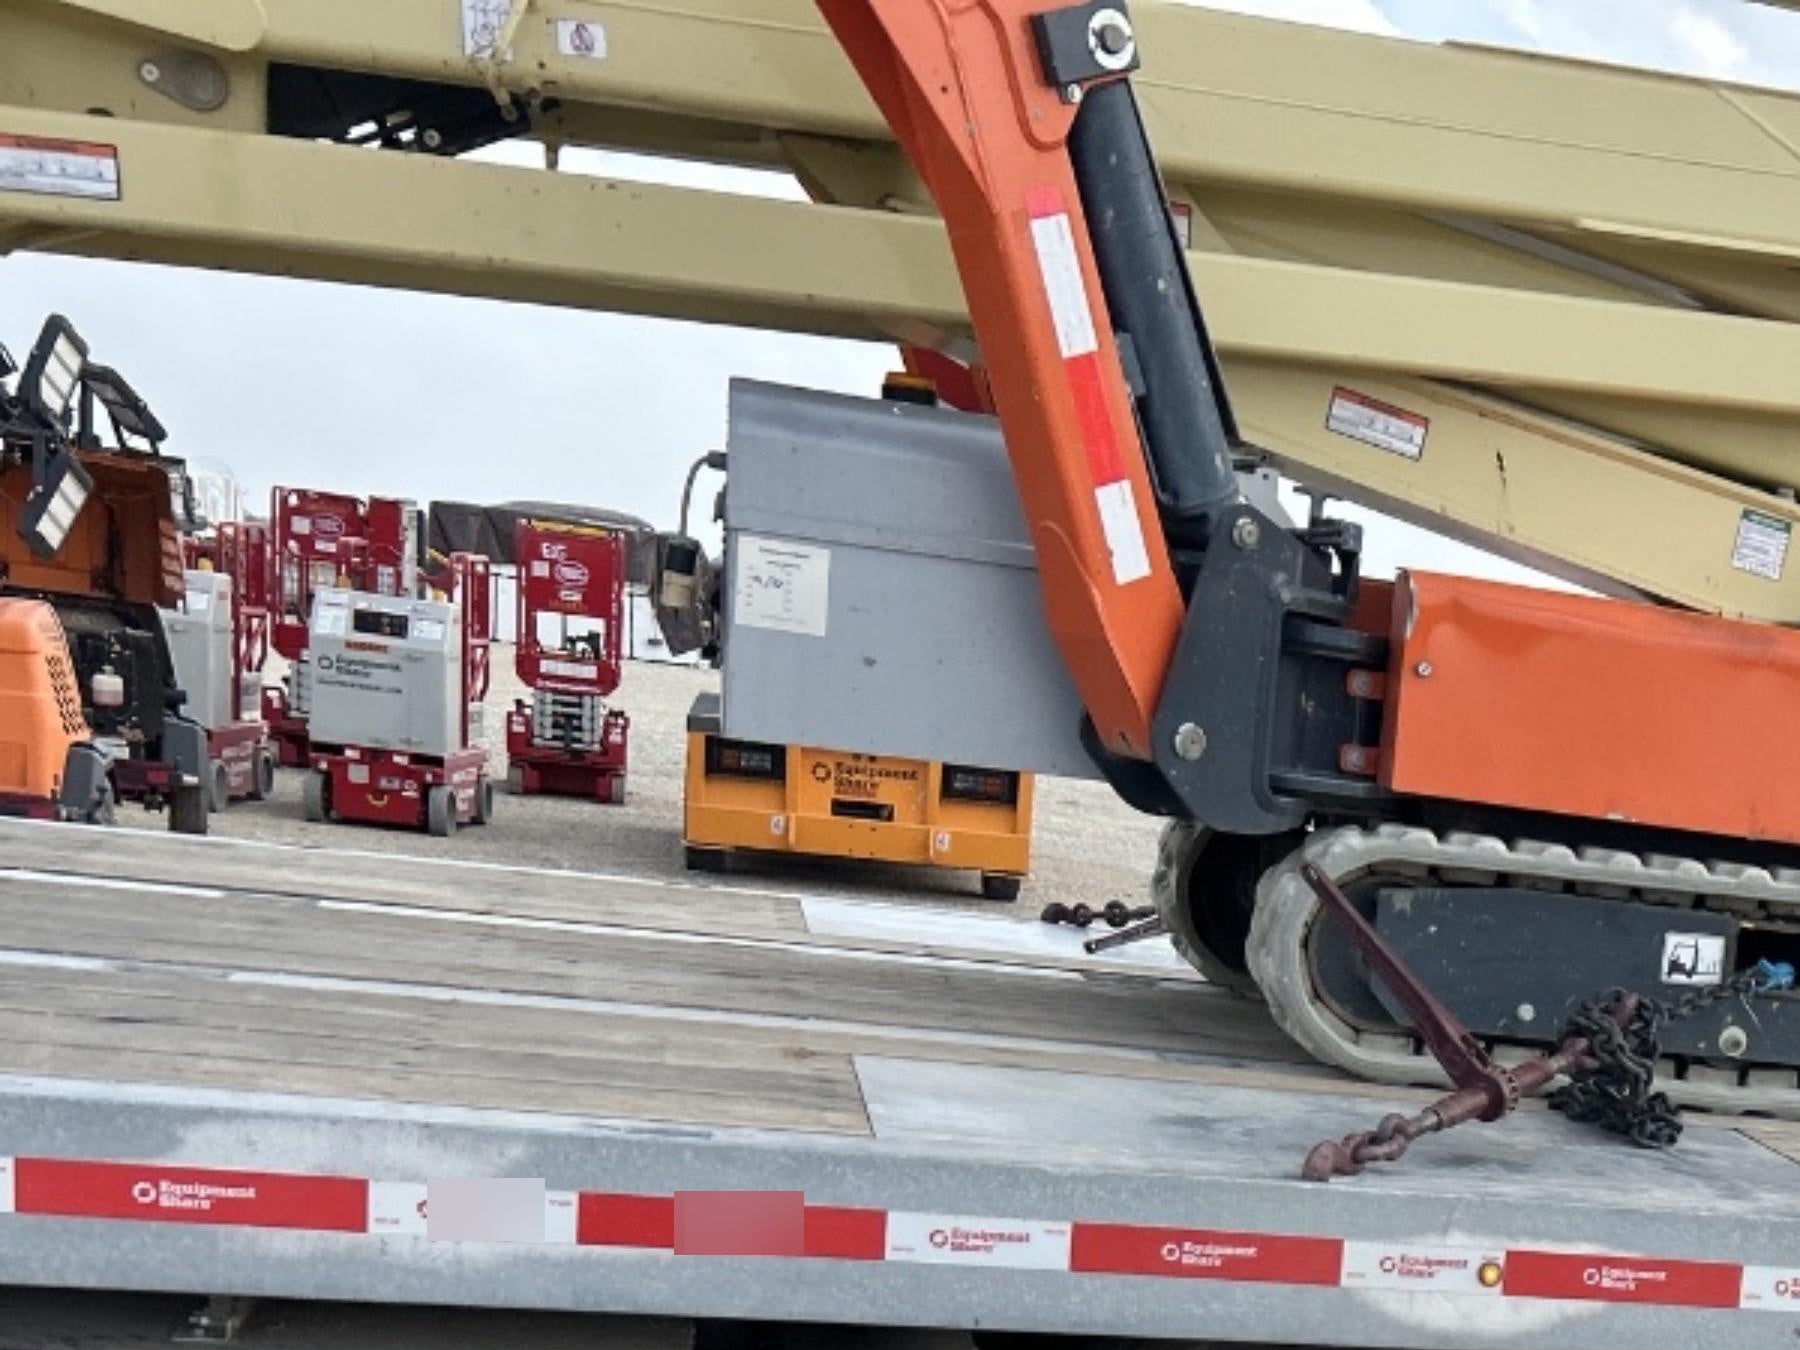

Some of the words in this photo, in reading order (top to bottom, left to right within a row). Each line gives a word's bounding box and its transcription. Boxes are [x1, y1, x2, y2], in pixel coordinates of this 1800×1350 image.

[834, 761, 918, 781] Equipment
[159, 1179, 256, 1200] Equipment
[159, 1194, 211, 1210] Share
[951, 1227, 1031, 1244] Equipment
[950, 1240, 994, 1254] Share
[1182, 1241, 1258, 1257] Equipment
[1181, 1254, 1222, 1268] Share
[1399, 1254, 1468, 1271] Equipment
[1601, 1266, 1667, 1282] Equipment
